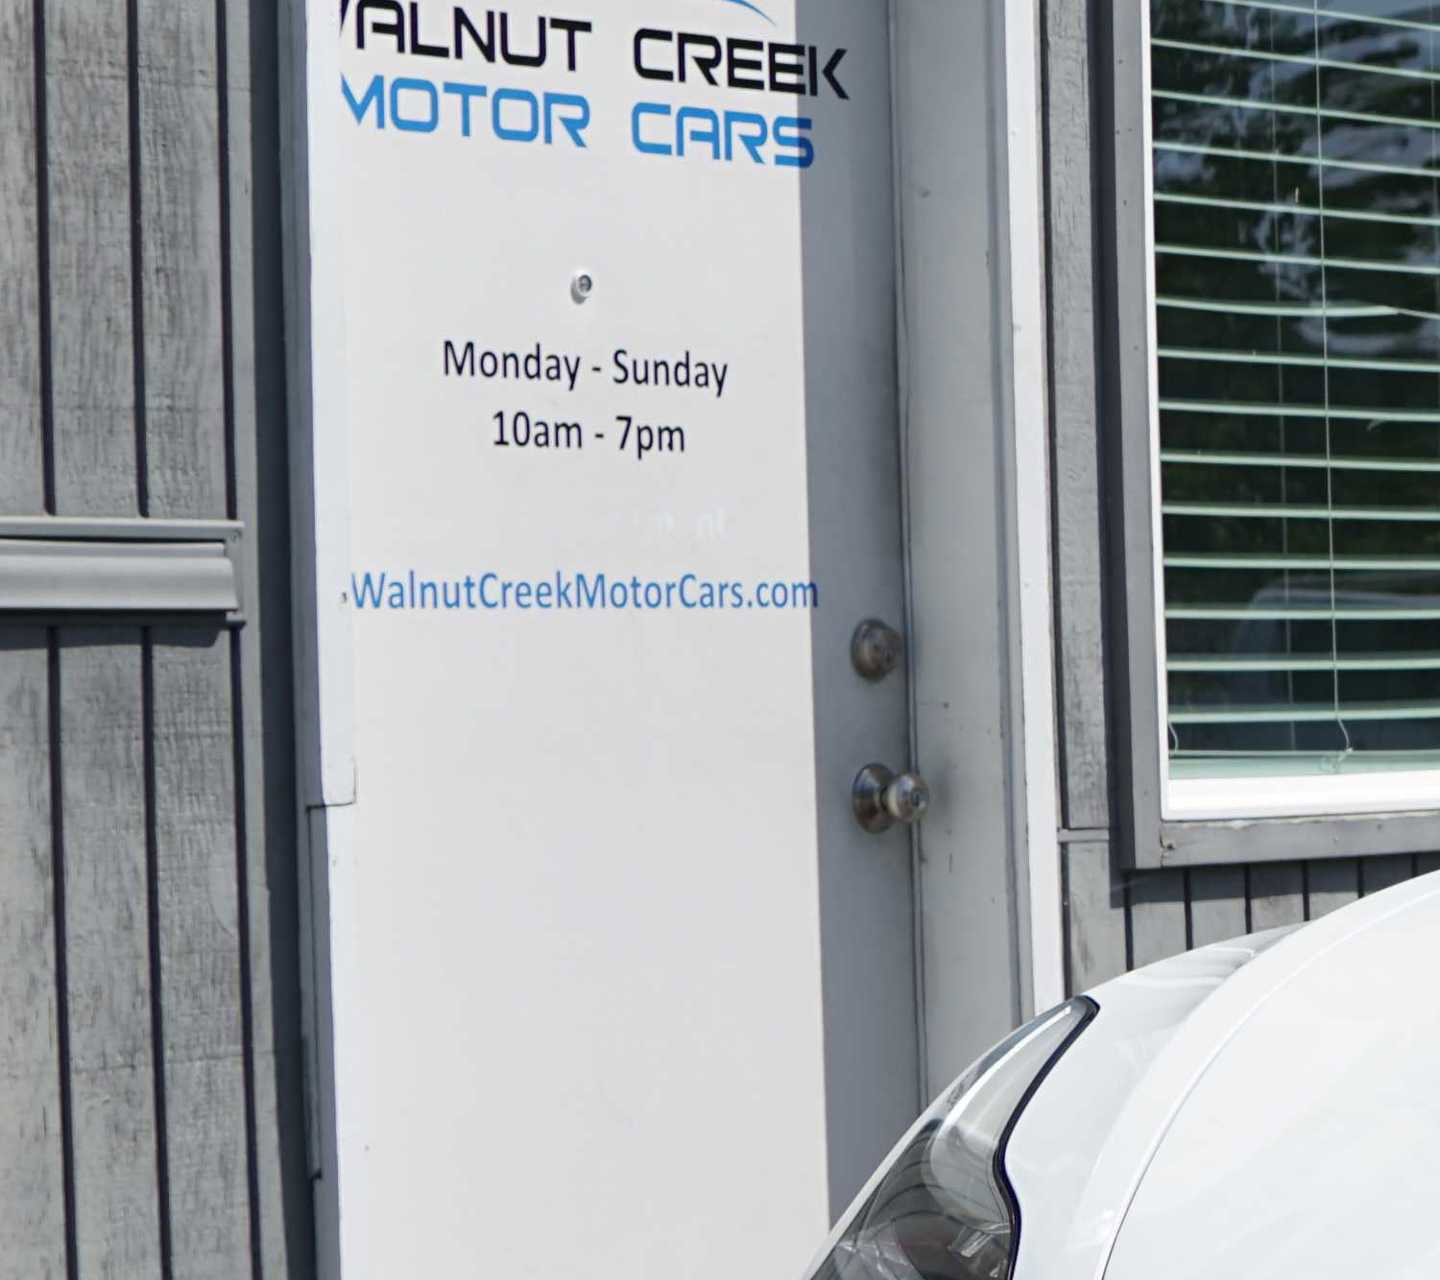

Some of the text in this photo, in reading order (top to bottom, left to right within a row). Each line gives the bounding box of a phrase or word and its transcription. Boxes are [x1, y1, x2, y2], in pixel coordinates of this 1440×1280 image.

[633, 28, 849, 100] CREEK
[340, 72, 814, 168] MOTOR CARS
[443, 340, 581, 390] Monday
[613, 349, 728, 398] Sunday
[493, 410, 583, 450] 10am
[615, 415, 686, 458] 7pm
[350, 570, 818, 610] WalnutCreekMotorCars.com
